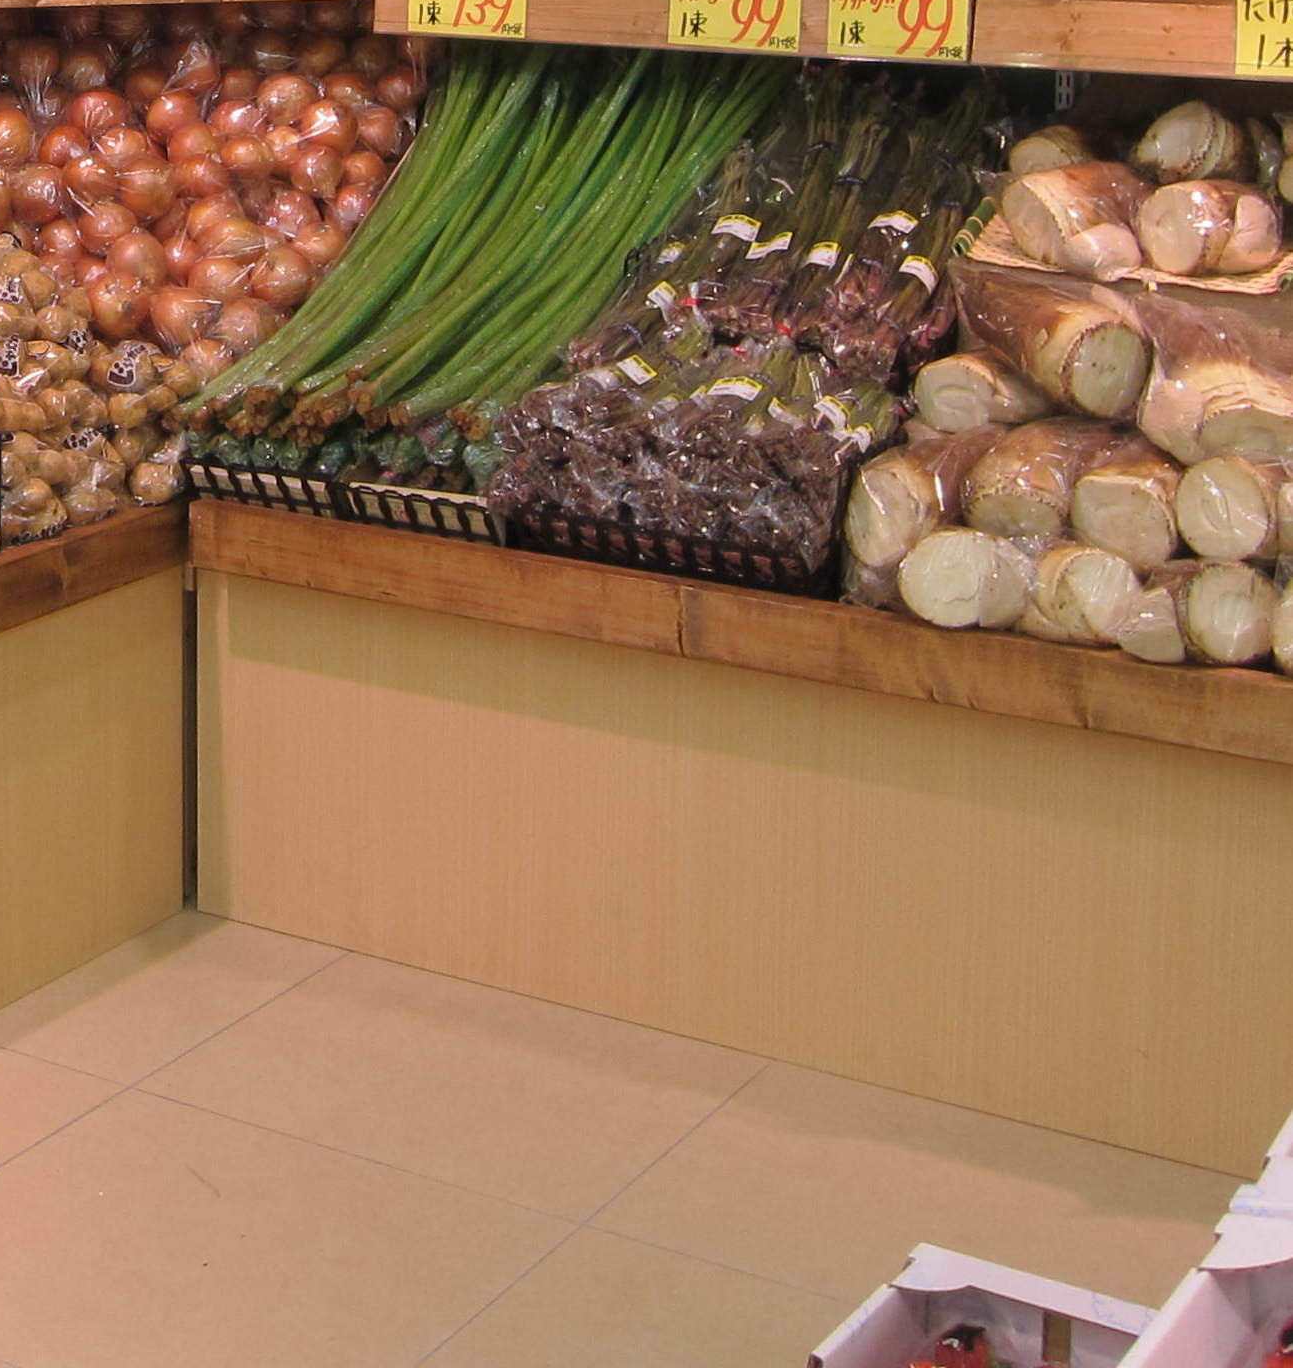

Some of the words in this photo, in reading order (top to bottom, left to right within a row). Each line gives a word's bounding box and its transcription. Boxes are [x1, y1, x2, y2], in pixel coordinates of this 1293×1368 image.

[419, 1, 441, 25] 1束
[681, 10, 708, 37] 1束
[840, 20, 865, 46] 1束
